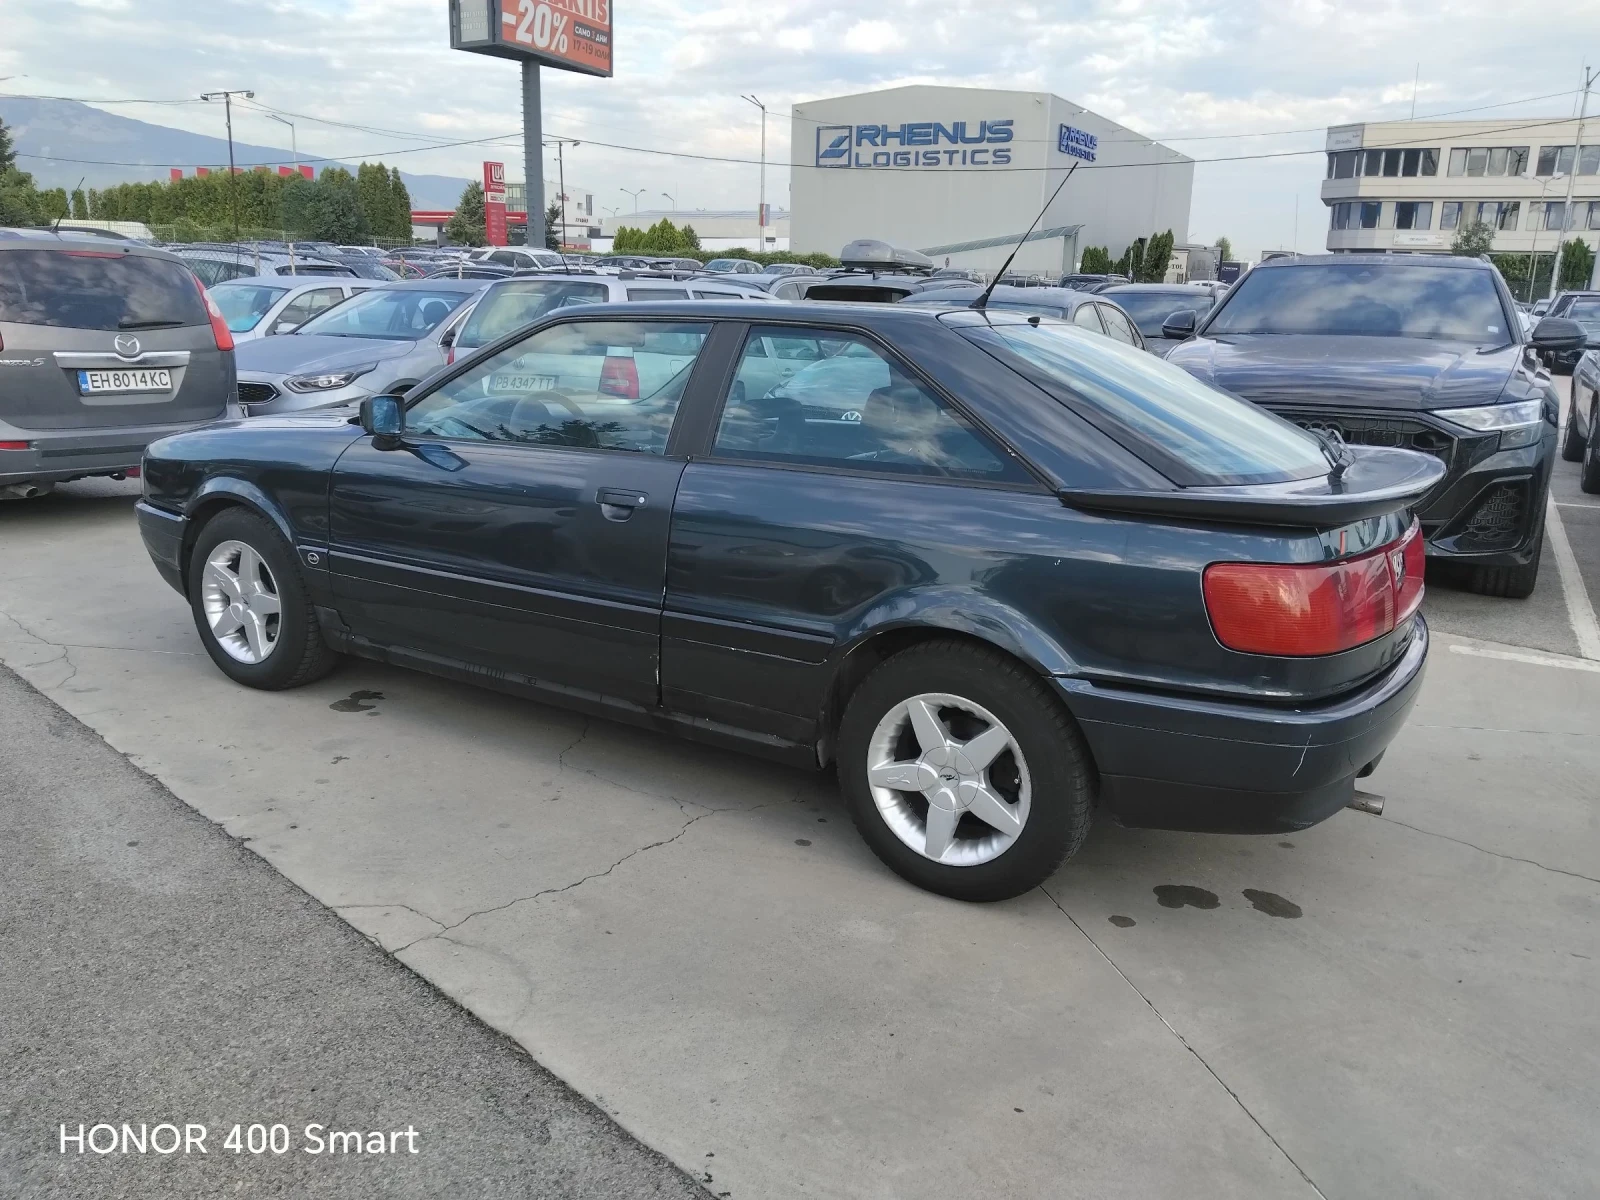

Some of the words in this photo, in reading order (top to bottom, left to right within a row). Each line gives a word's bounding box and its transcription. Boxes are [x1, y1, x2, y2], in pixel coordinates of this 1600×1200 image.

[502, 0, 568, 53] -20%
[574, 26, 591, 37] САМО
[591, 31, 596, 39] 3
[855, 120, 1013, 147] RHENUS
[854, 148, 1012, 167] LOGISTICS
